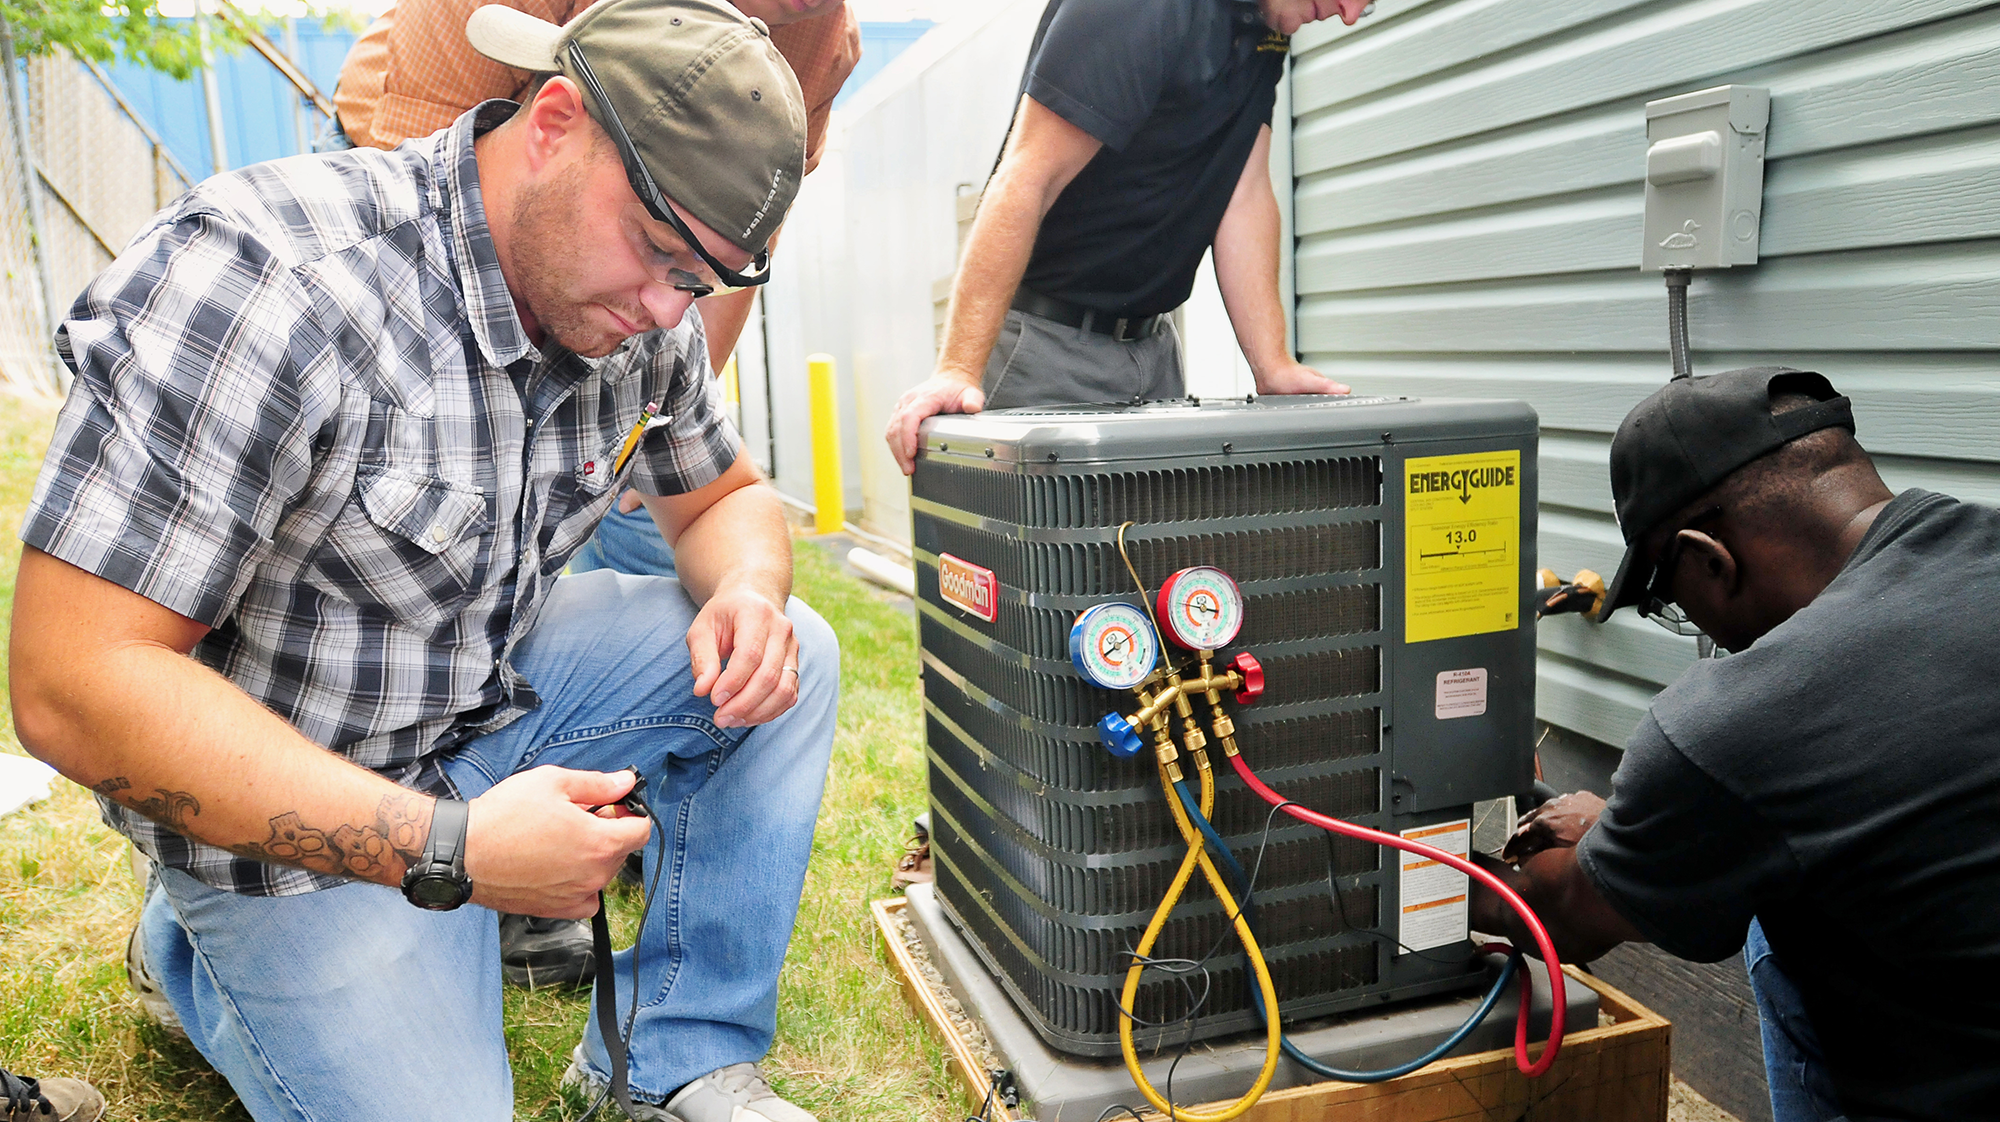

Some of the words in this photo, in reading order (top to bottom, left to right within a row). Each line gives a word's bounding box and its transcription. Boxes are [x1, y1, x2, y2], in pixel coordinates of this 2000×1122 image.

[1446, 530, 1476, 544] 13.0
[941, 563, 989, 608] Goodman
[1443, 676, 1480, 685] REFRIGERANT
